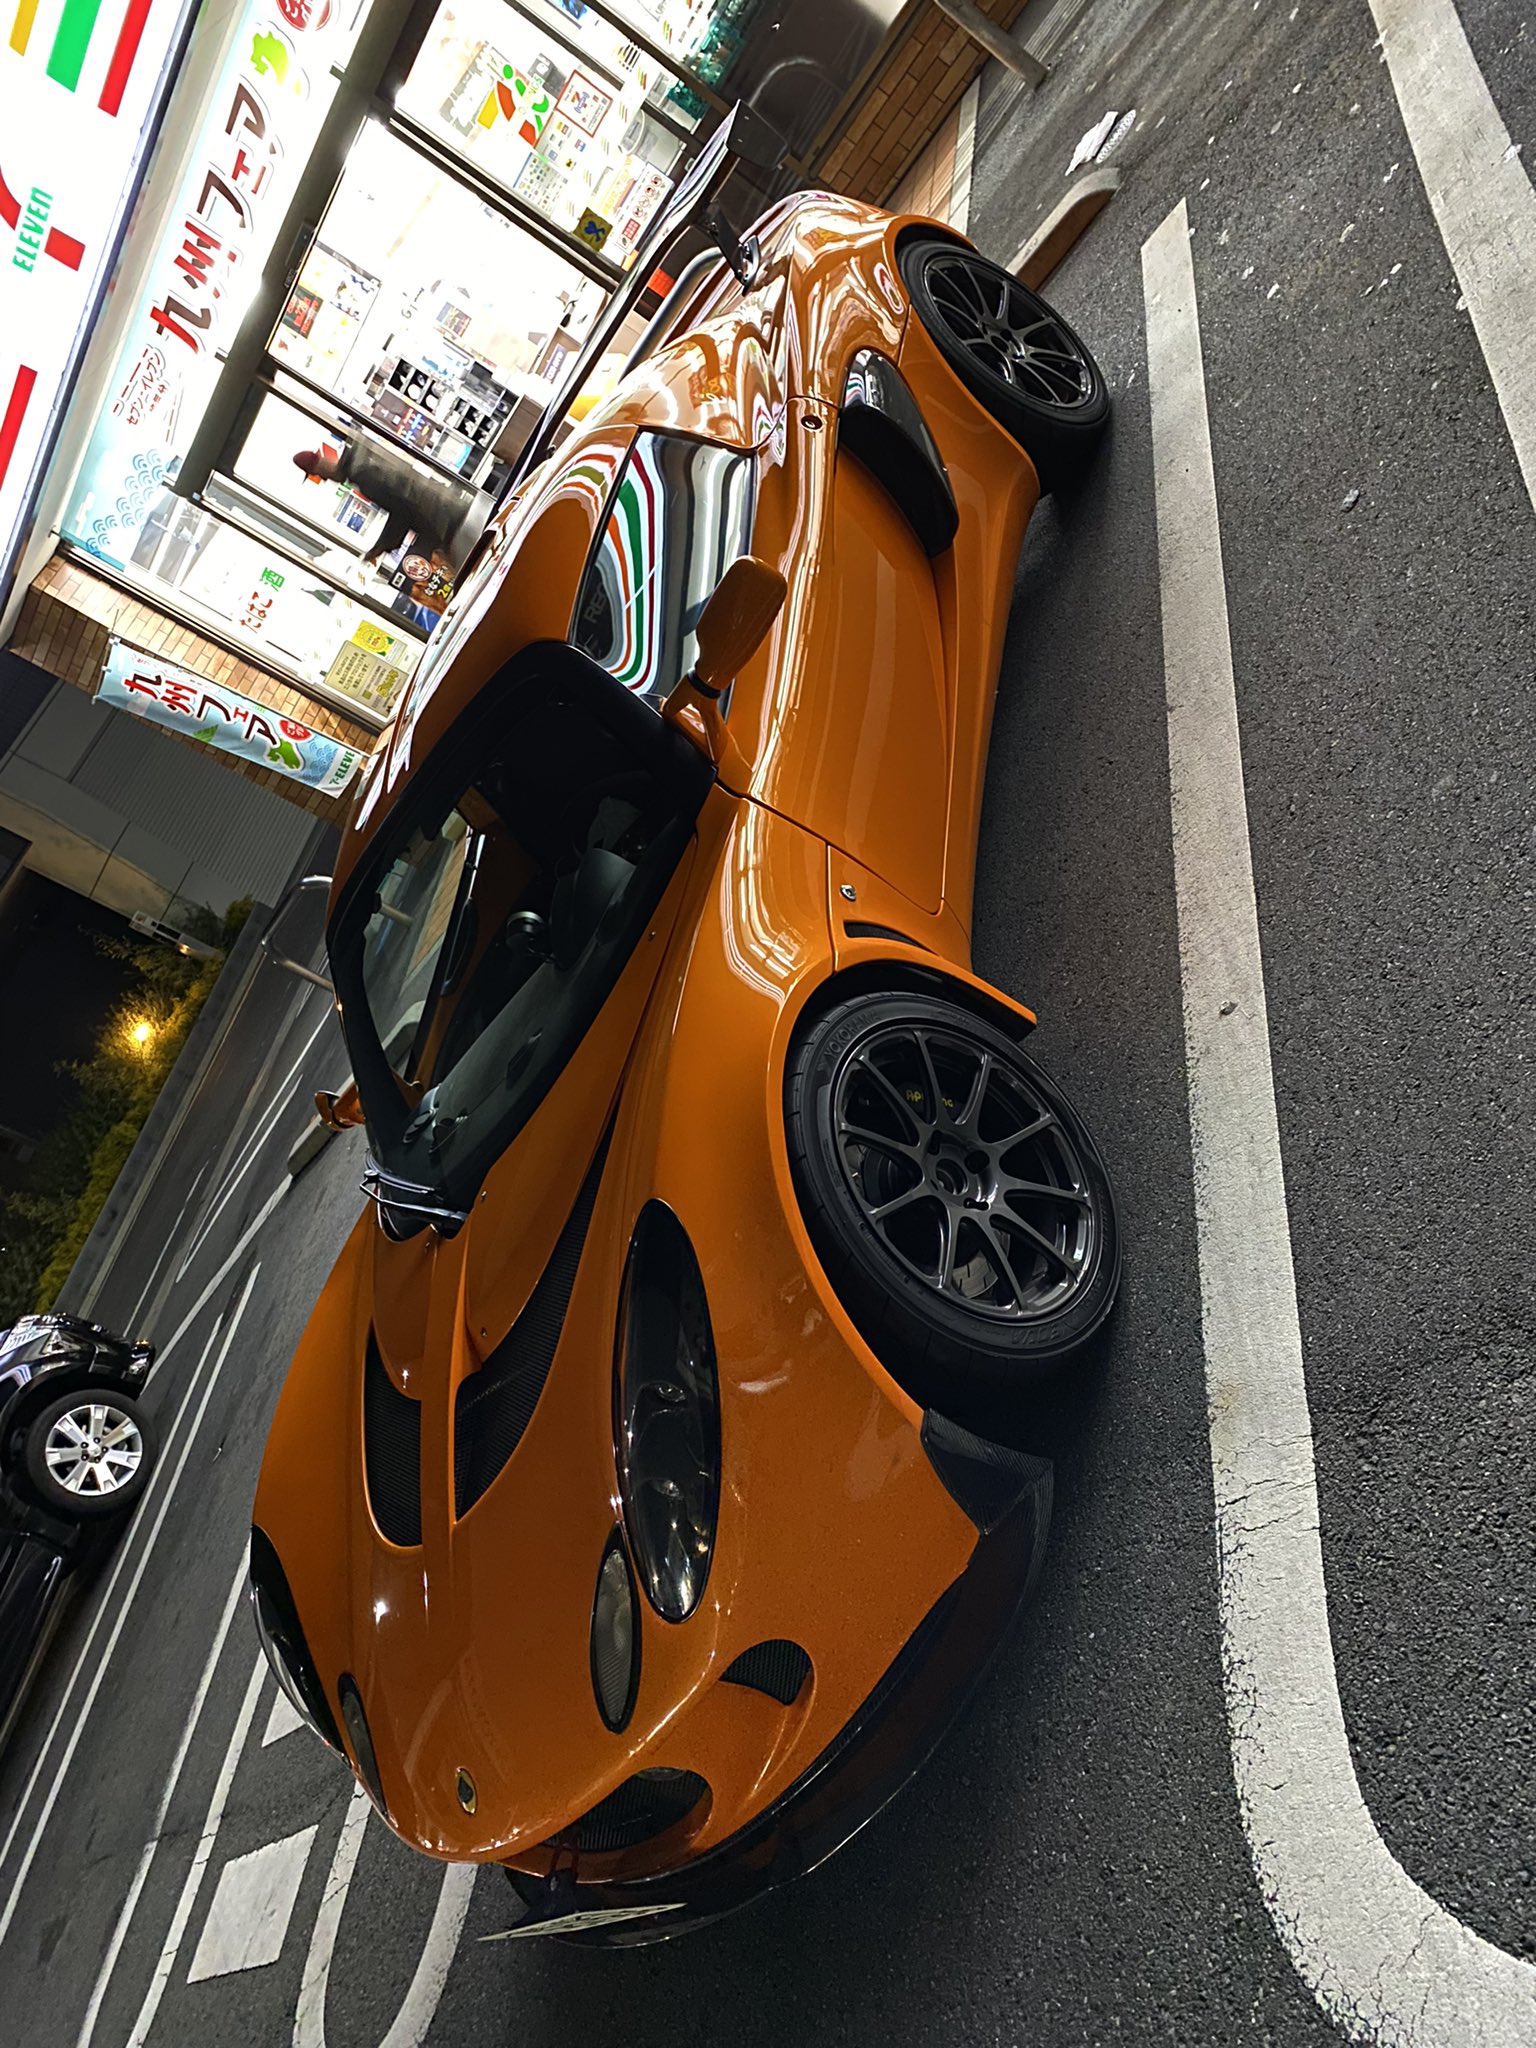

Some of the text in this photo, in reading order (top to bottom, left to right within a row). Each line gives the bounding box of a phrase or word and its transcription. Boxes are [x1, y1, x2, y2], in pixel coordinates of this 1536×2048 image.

[150, 82, 276, 354] 九州フェア
[259, 567, 285, 592] 酒
[123, 672, 279, 745] 九州フェア
